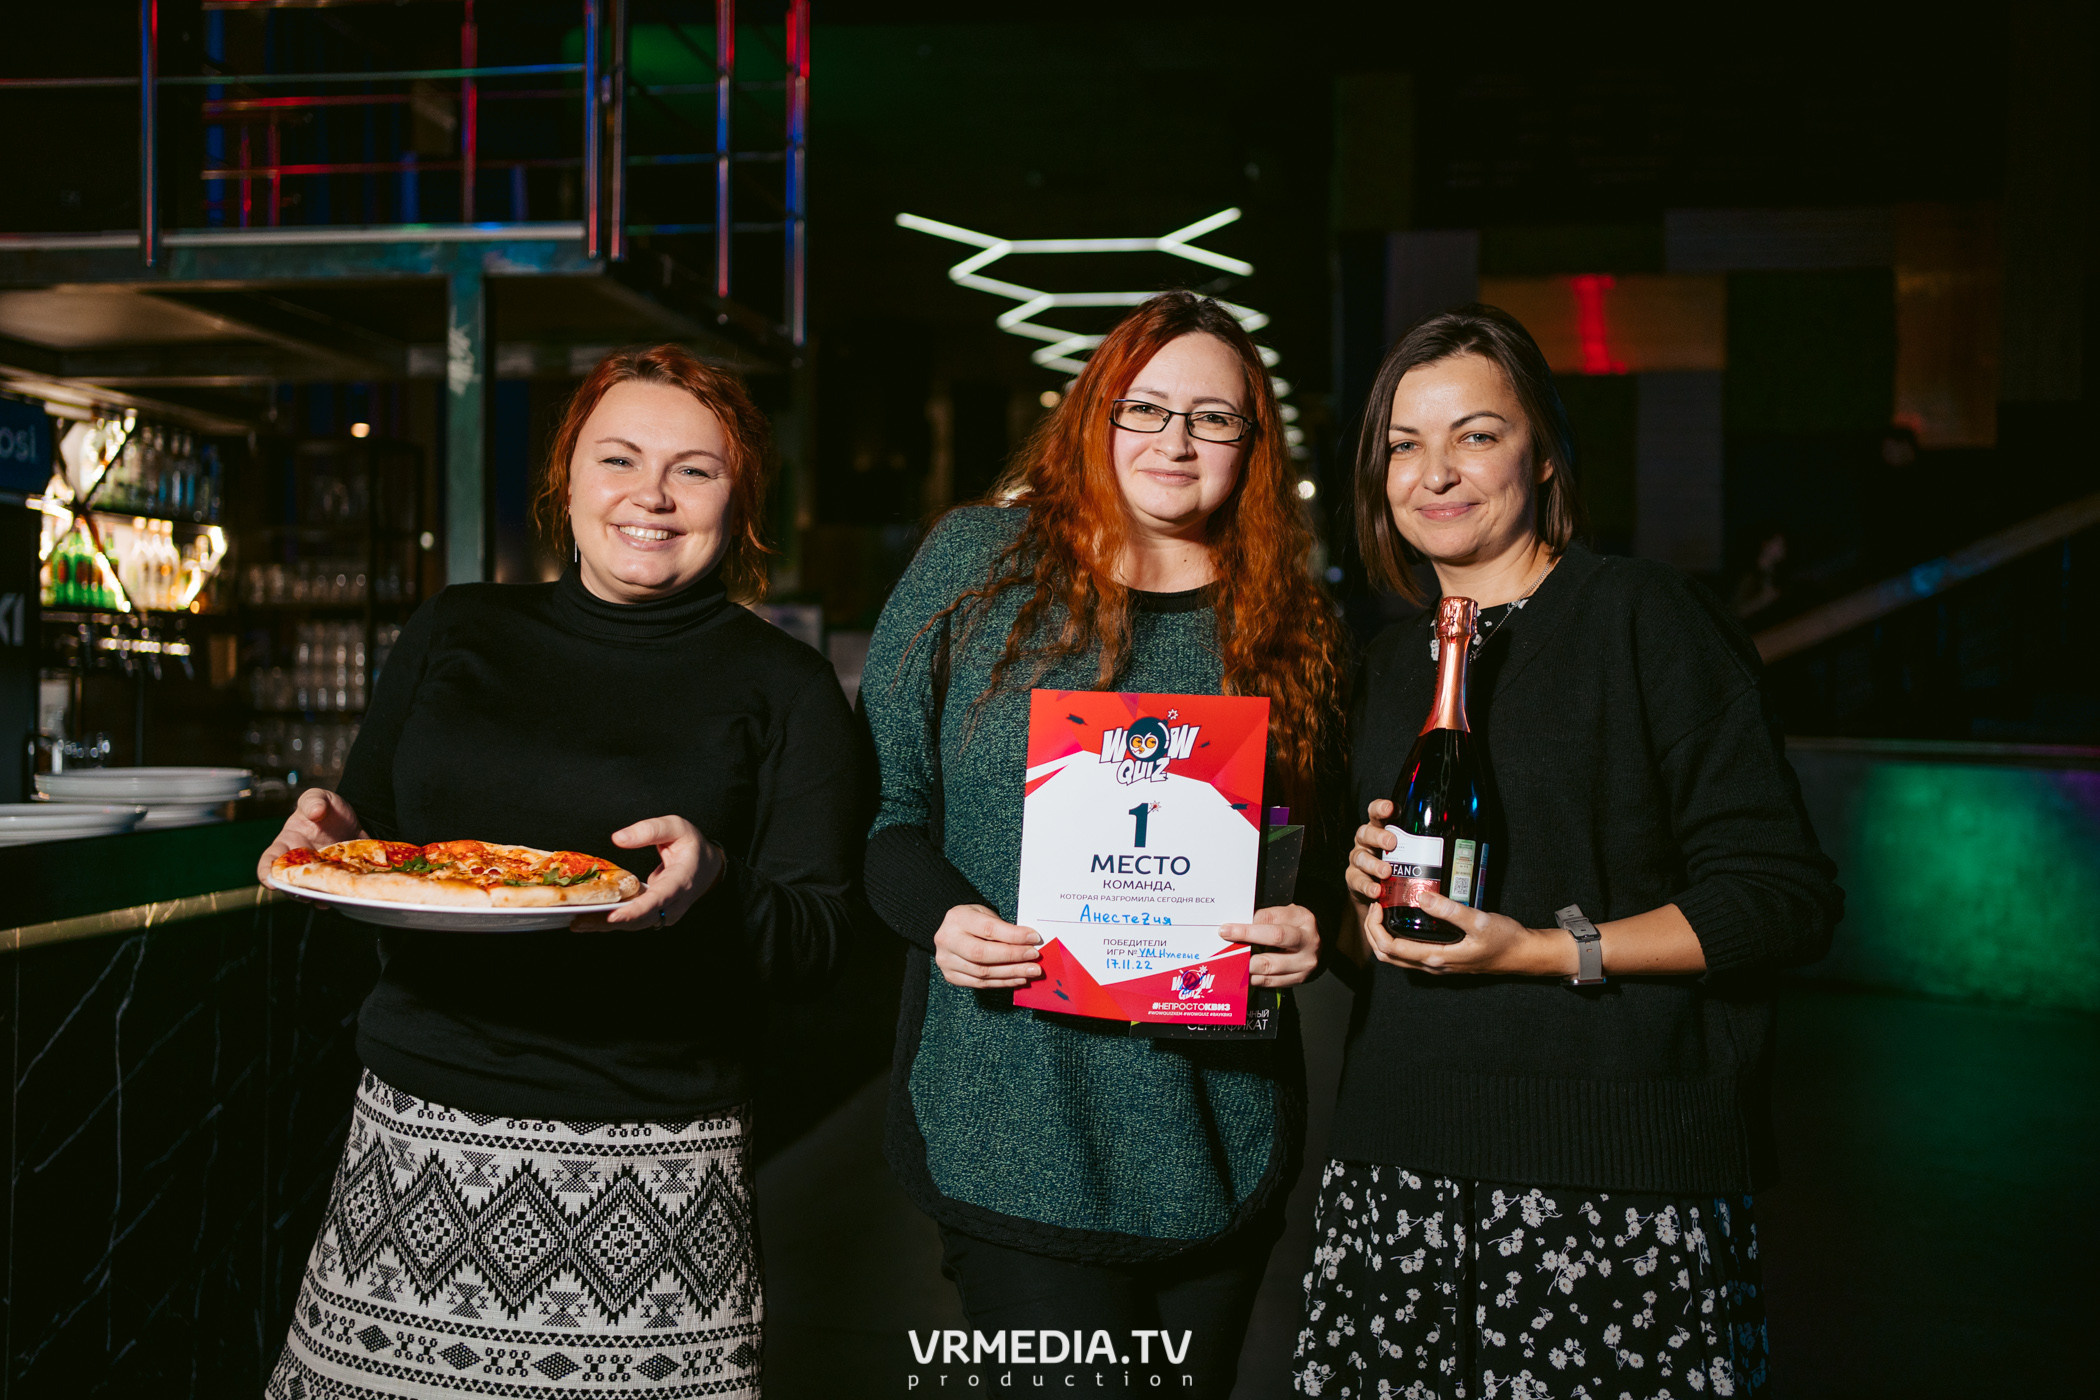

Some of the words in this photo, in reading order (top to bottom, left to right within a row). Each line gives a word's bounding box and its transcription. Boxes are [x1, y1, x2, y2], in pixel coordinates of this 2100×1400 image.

[1116, 756, 1171, 786] QUIZ
[1128, 803, 1149, 848] 1
[1091, 854, 1191, 876] МЕСТО
[1390, 864, 1422, 877] FANO
[1103, 879, 1176, 892] КОМАНДА,
[1060, 893, 1099, 901] КОТОРАЯ
[1100, 895, 1155, 903] РАЗГРОМИЛА
[1103, 938, 1167, 948] ПОБЕДИТЕЛИ
[1106, 958, 1153, 970] 17.11.22
[1152, 1002, 1231, 1011] #НЕПРОСТОКВИЗ
